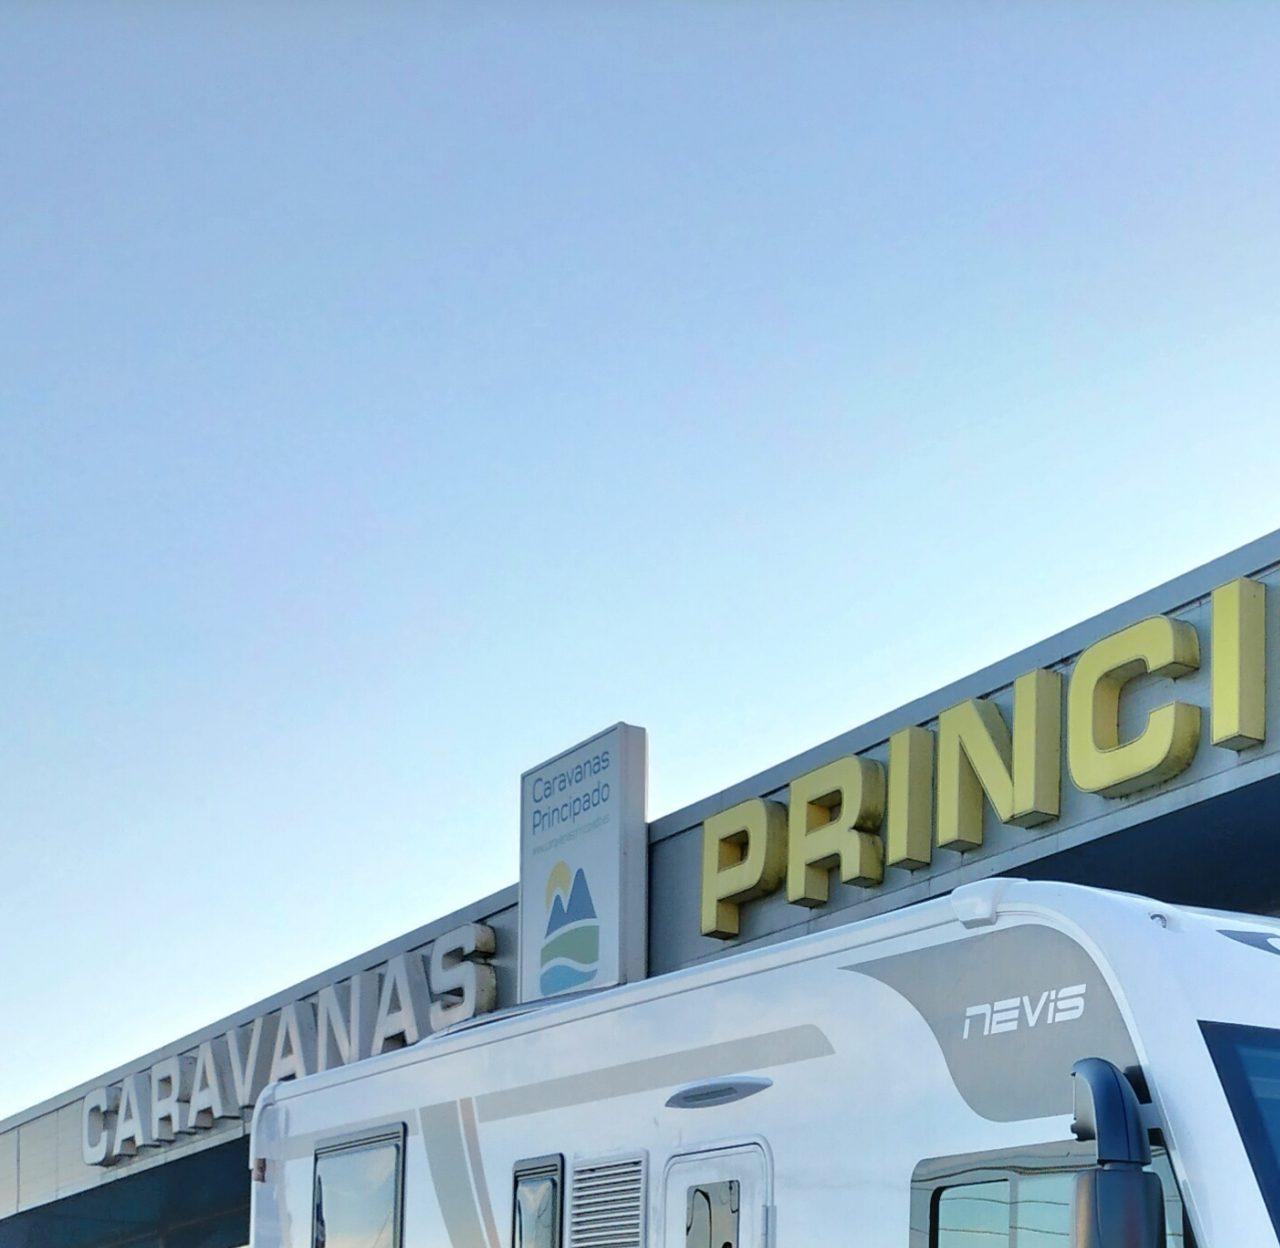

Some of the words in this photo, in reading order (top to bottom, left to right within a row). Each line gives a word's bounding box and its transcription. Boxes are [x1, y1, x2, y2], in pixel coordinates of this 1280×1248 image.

[532, 751, 610, 803] Caravanas
[532, 781, 610, 835] Principado
[82, 922, 496, 1166] CARAVANAS
